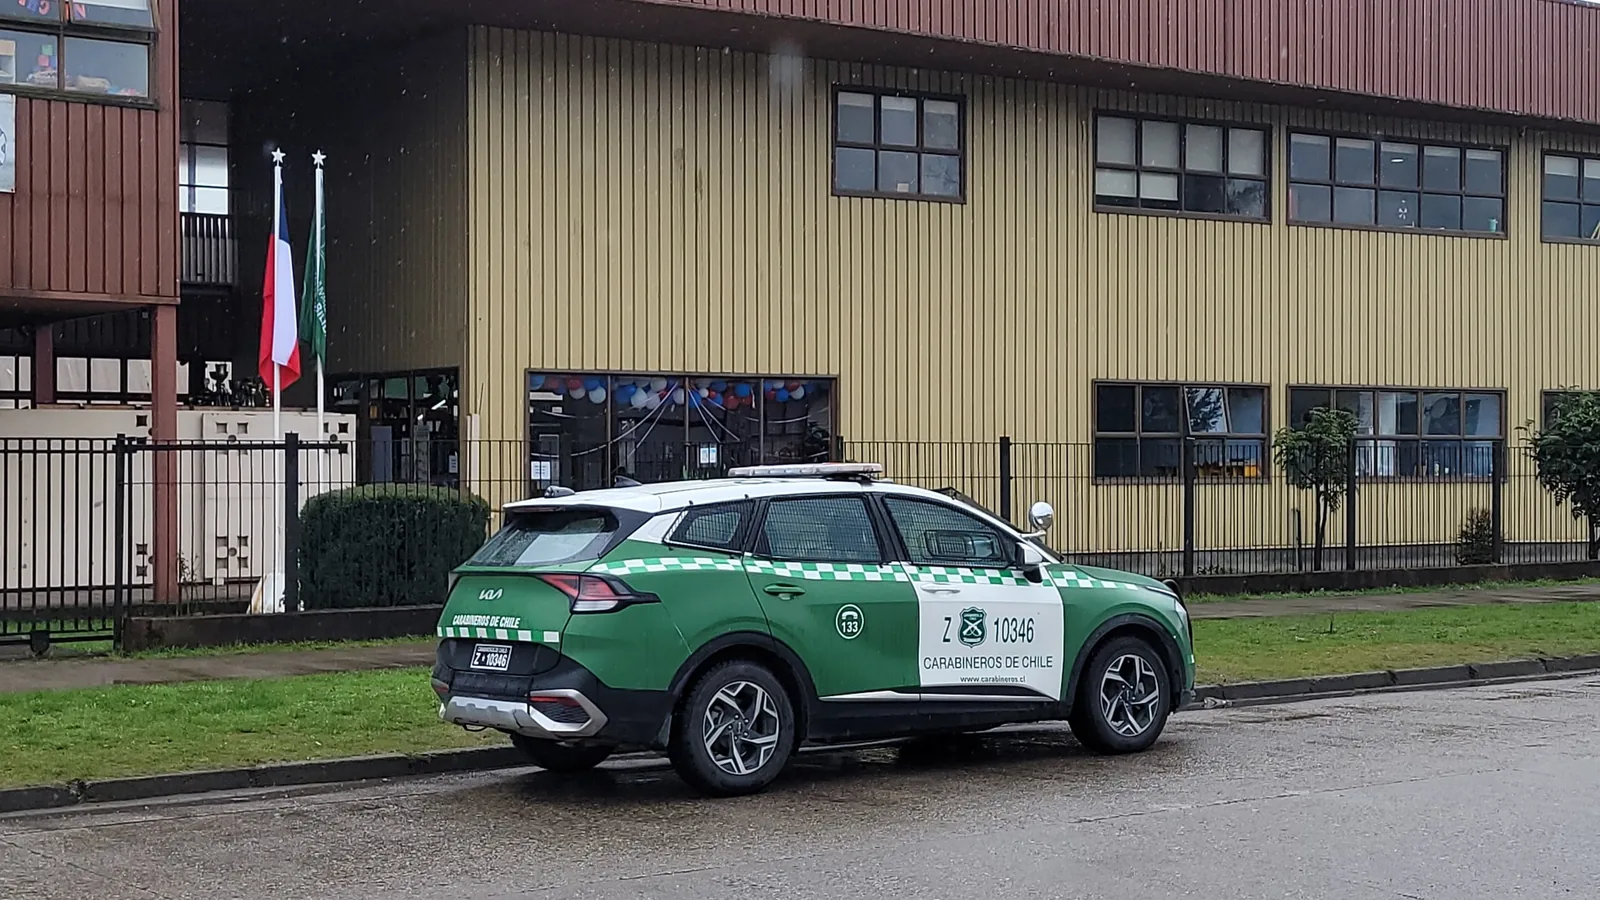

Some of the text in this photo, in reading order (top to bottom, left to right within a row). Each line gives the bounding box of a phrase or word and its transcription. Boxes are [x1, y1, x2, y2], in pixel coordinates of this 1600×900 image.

[479, 589, 503, 600] KIA
[453, 615, 520, 628] CARABINEROS DE CHILE
[841, 621, 858, 633] 133
[943, 617, 1035, 643] Z 10346
[473, 652, 508, 667] Z 10346
[923, 656, 1053, 670] CARABINEROS DE CHILE
[960, 675, 1026, 683] www.carabineros.cl
